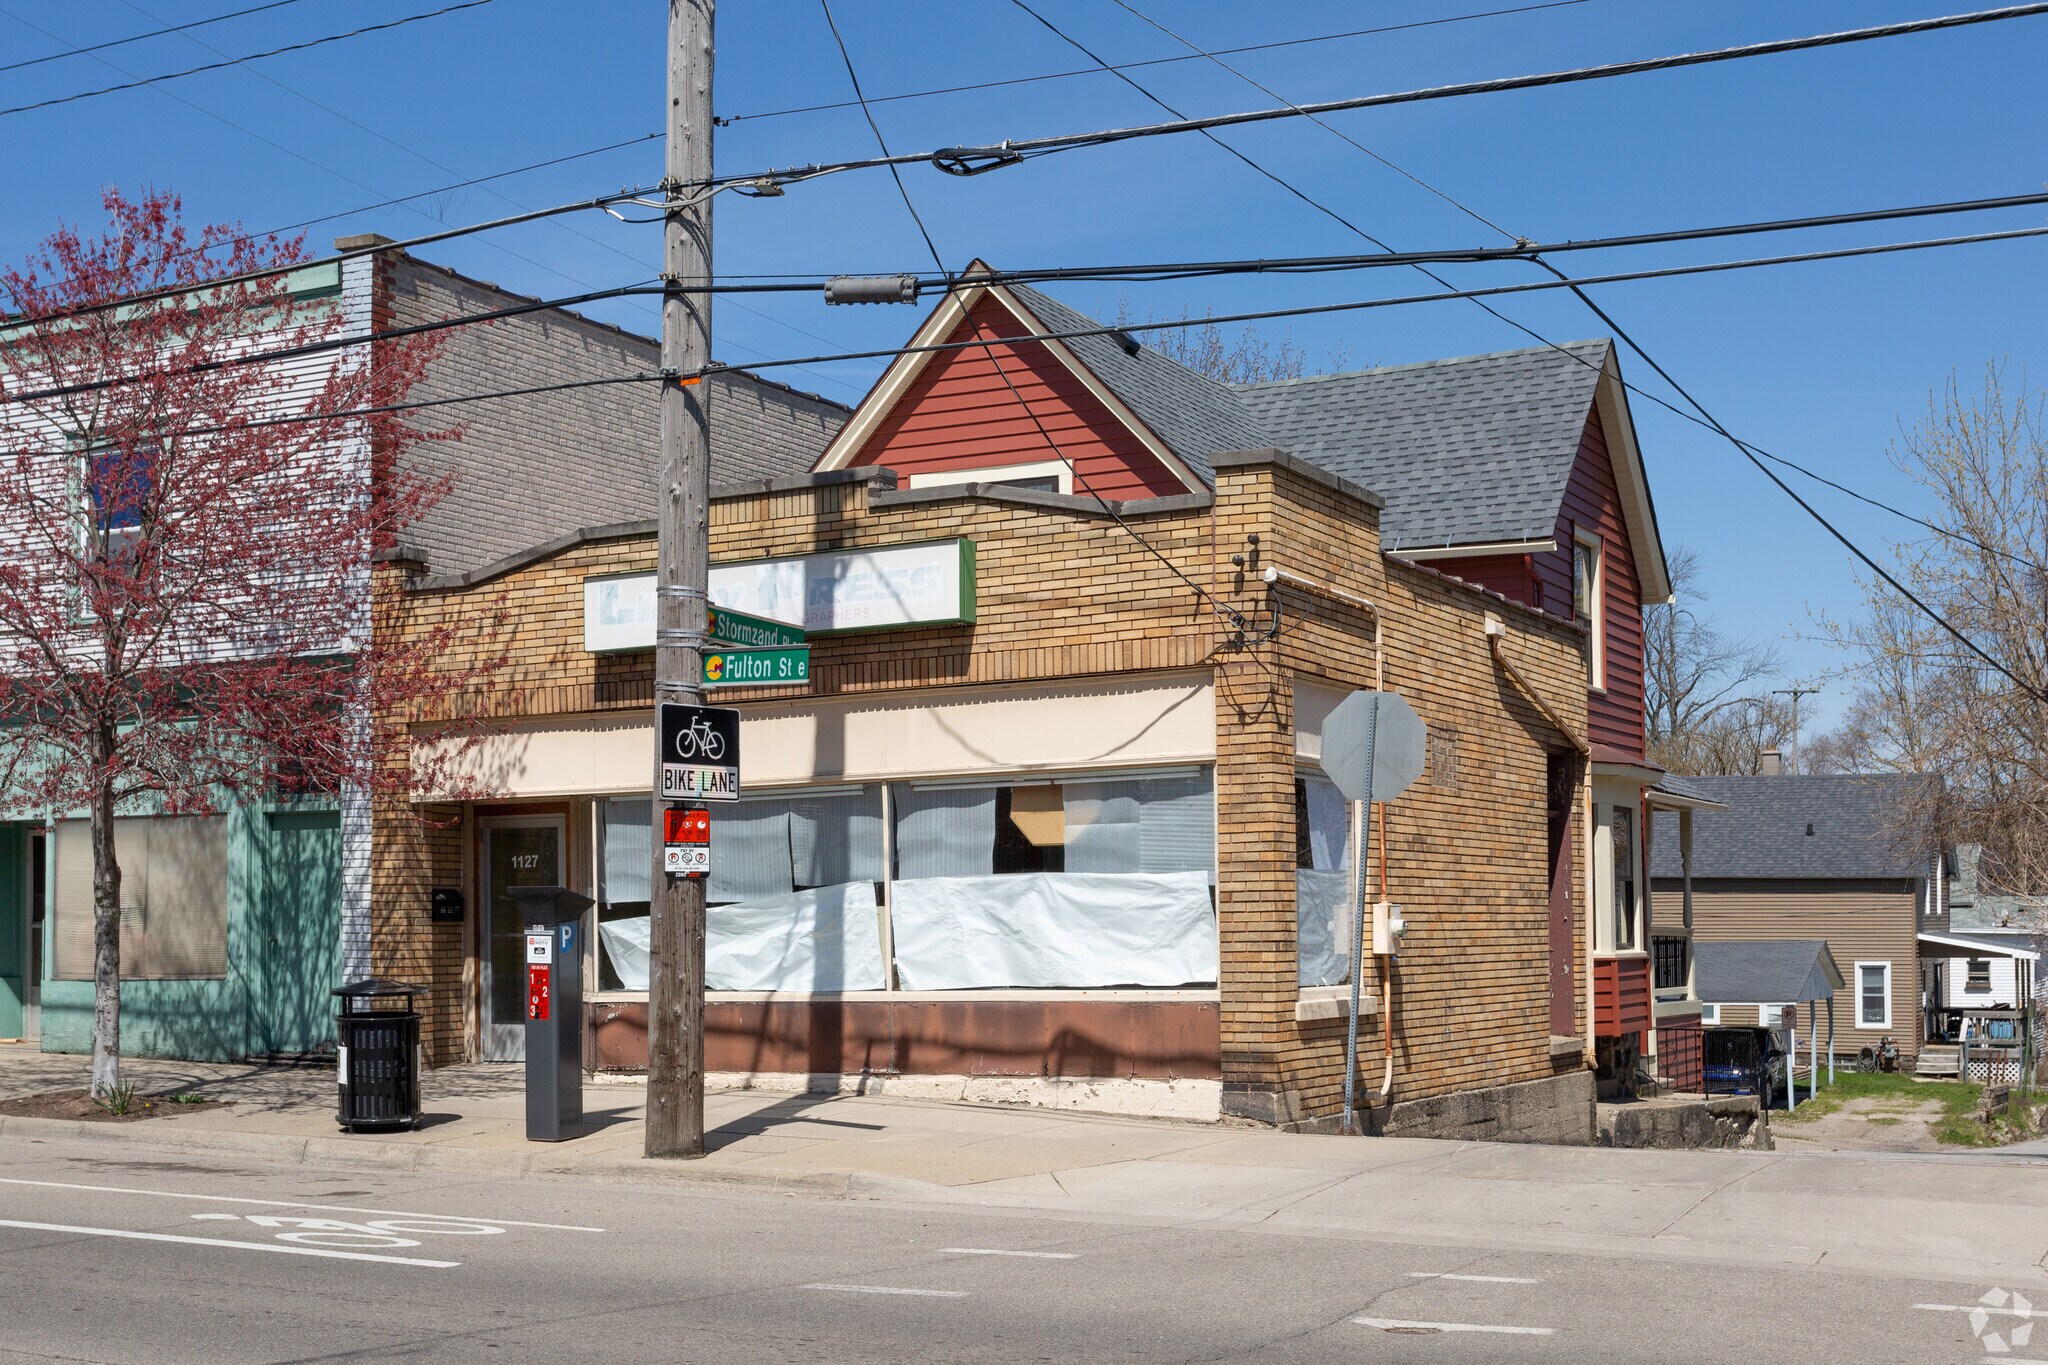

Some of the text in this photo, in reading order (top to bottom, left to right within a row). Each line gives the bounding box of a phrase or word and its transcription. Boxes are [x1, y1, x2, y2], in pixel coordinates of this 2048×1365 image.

[717, 613, 778, 646] Stormzand
[726, 655, 805, 679] Fulton St e
[665, 769, 736, 793] BIKE LANE
[511, 855, 539, 869] 1127
[562, 925, 572, 948] P
[530, 973, 535, 984] 1
[542, 986, 548, 997] 2
[530, 1005, 536, 1017] 3
